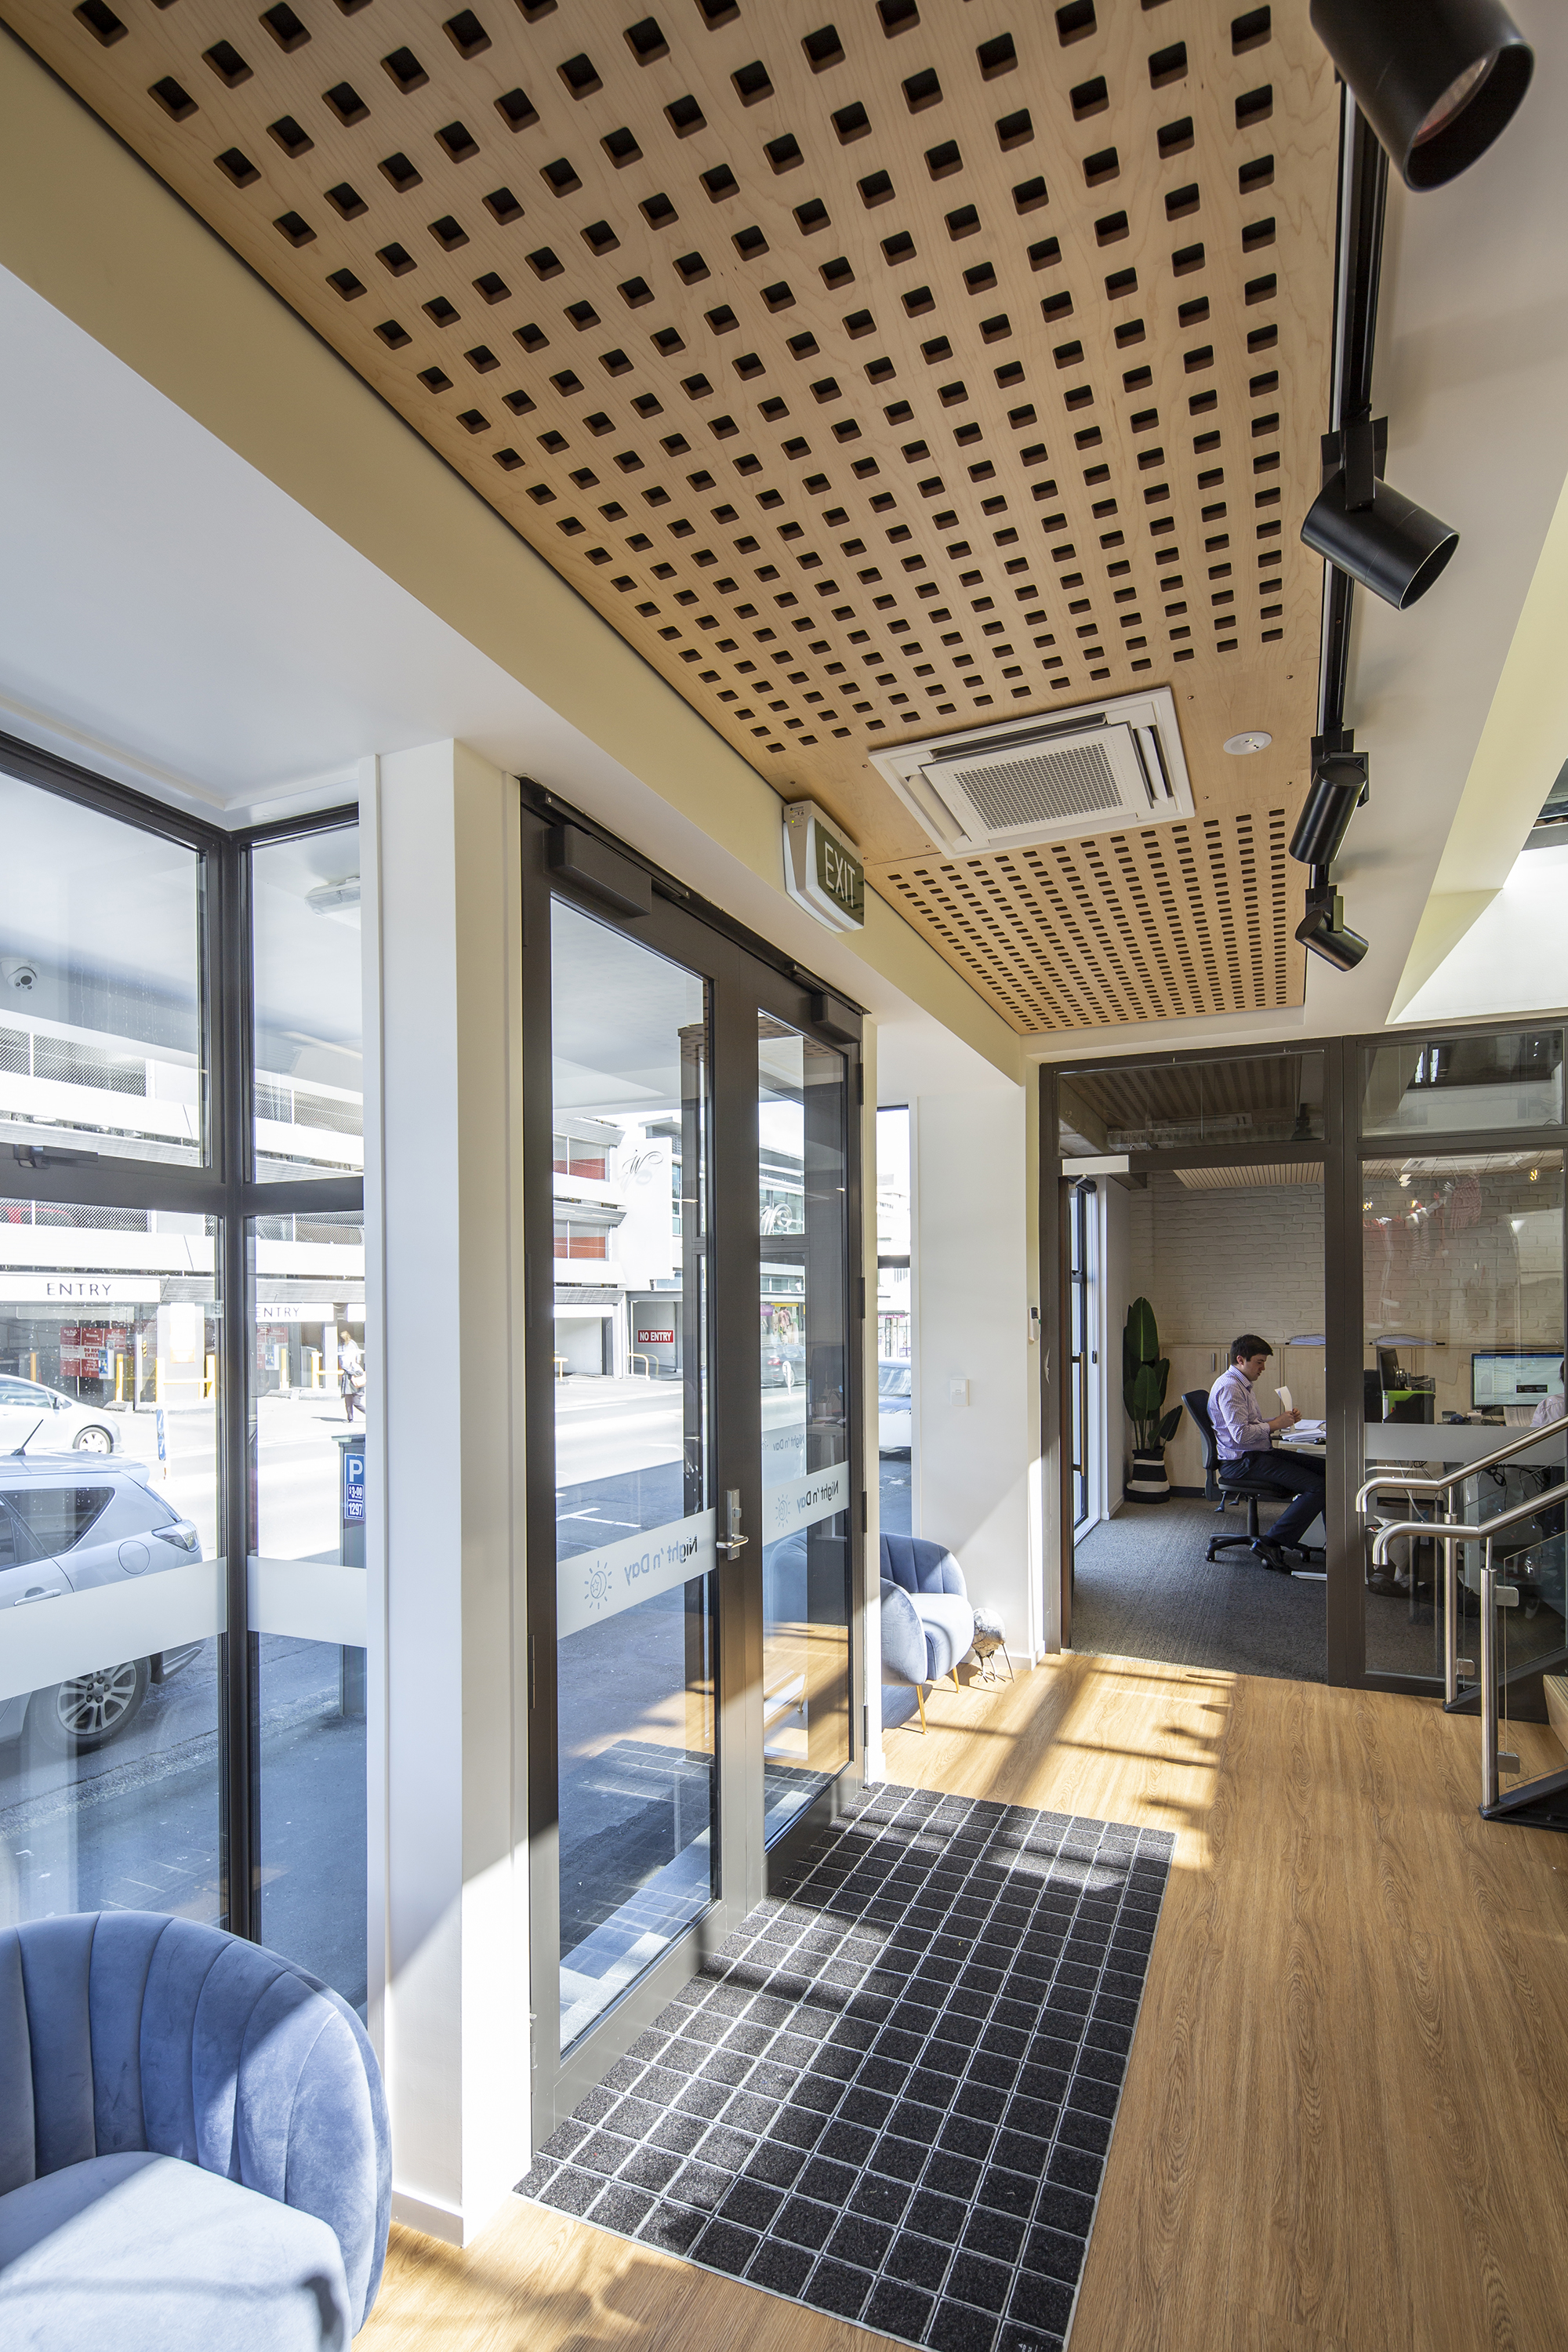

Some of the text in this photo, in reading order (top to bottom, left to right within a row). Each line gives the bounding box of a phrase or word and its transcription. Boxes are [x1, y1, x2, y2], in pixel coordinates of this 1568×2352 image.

[825, 841, 855, 908] EXIT
[47, 1283, 111, 1296] ENTRY
[640, 1332, 672, 1341] NO ENTRY
[349, 1459, 363, 1483] P
[348, 1502, 363, 1515] 1297
